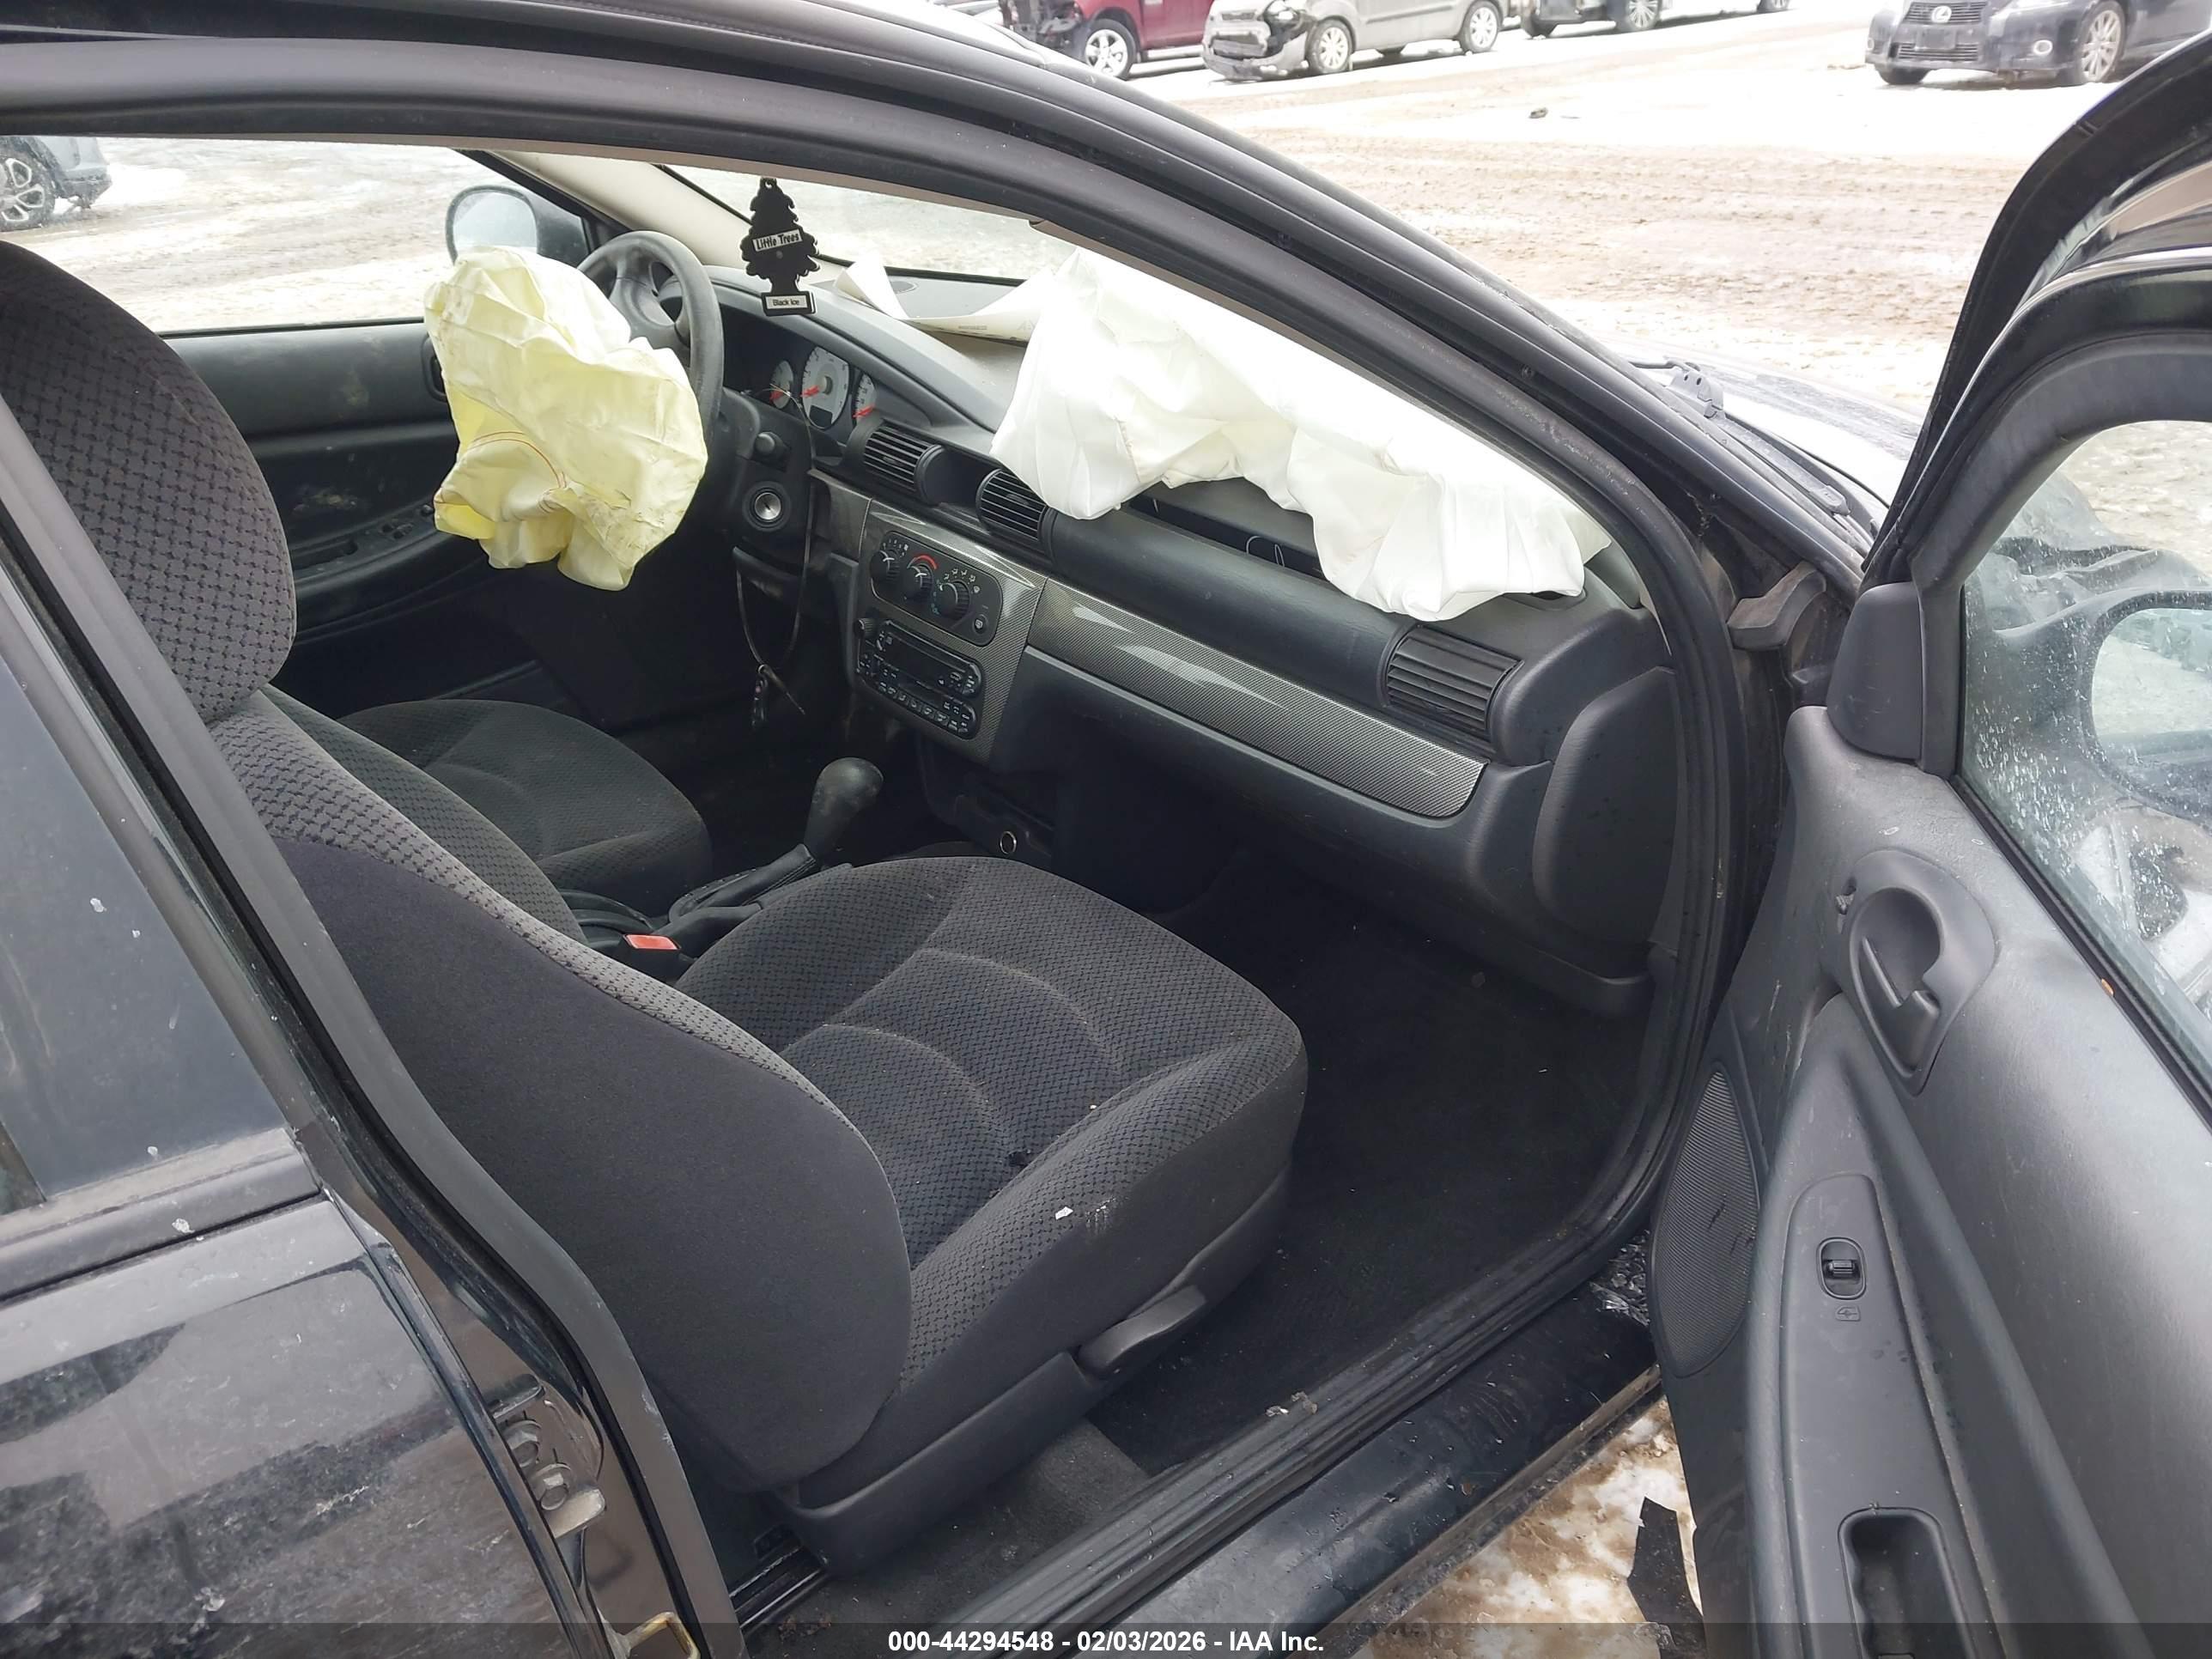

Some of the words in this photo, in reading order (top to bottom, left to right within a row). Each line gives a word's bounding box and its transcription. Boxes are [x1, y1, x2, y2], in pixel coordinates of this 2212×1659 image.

[756, 235, 777, 250] Little
[777, 233, 799, 245] Trees
[772, 298, 789, 307] Black
